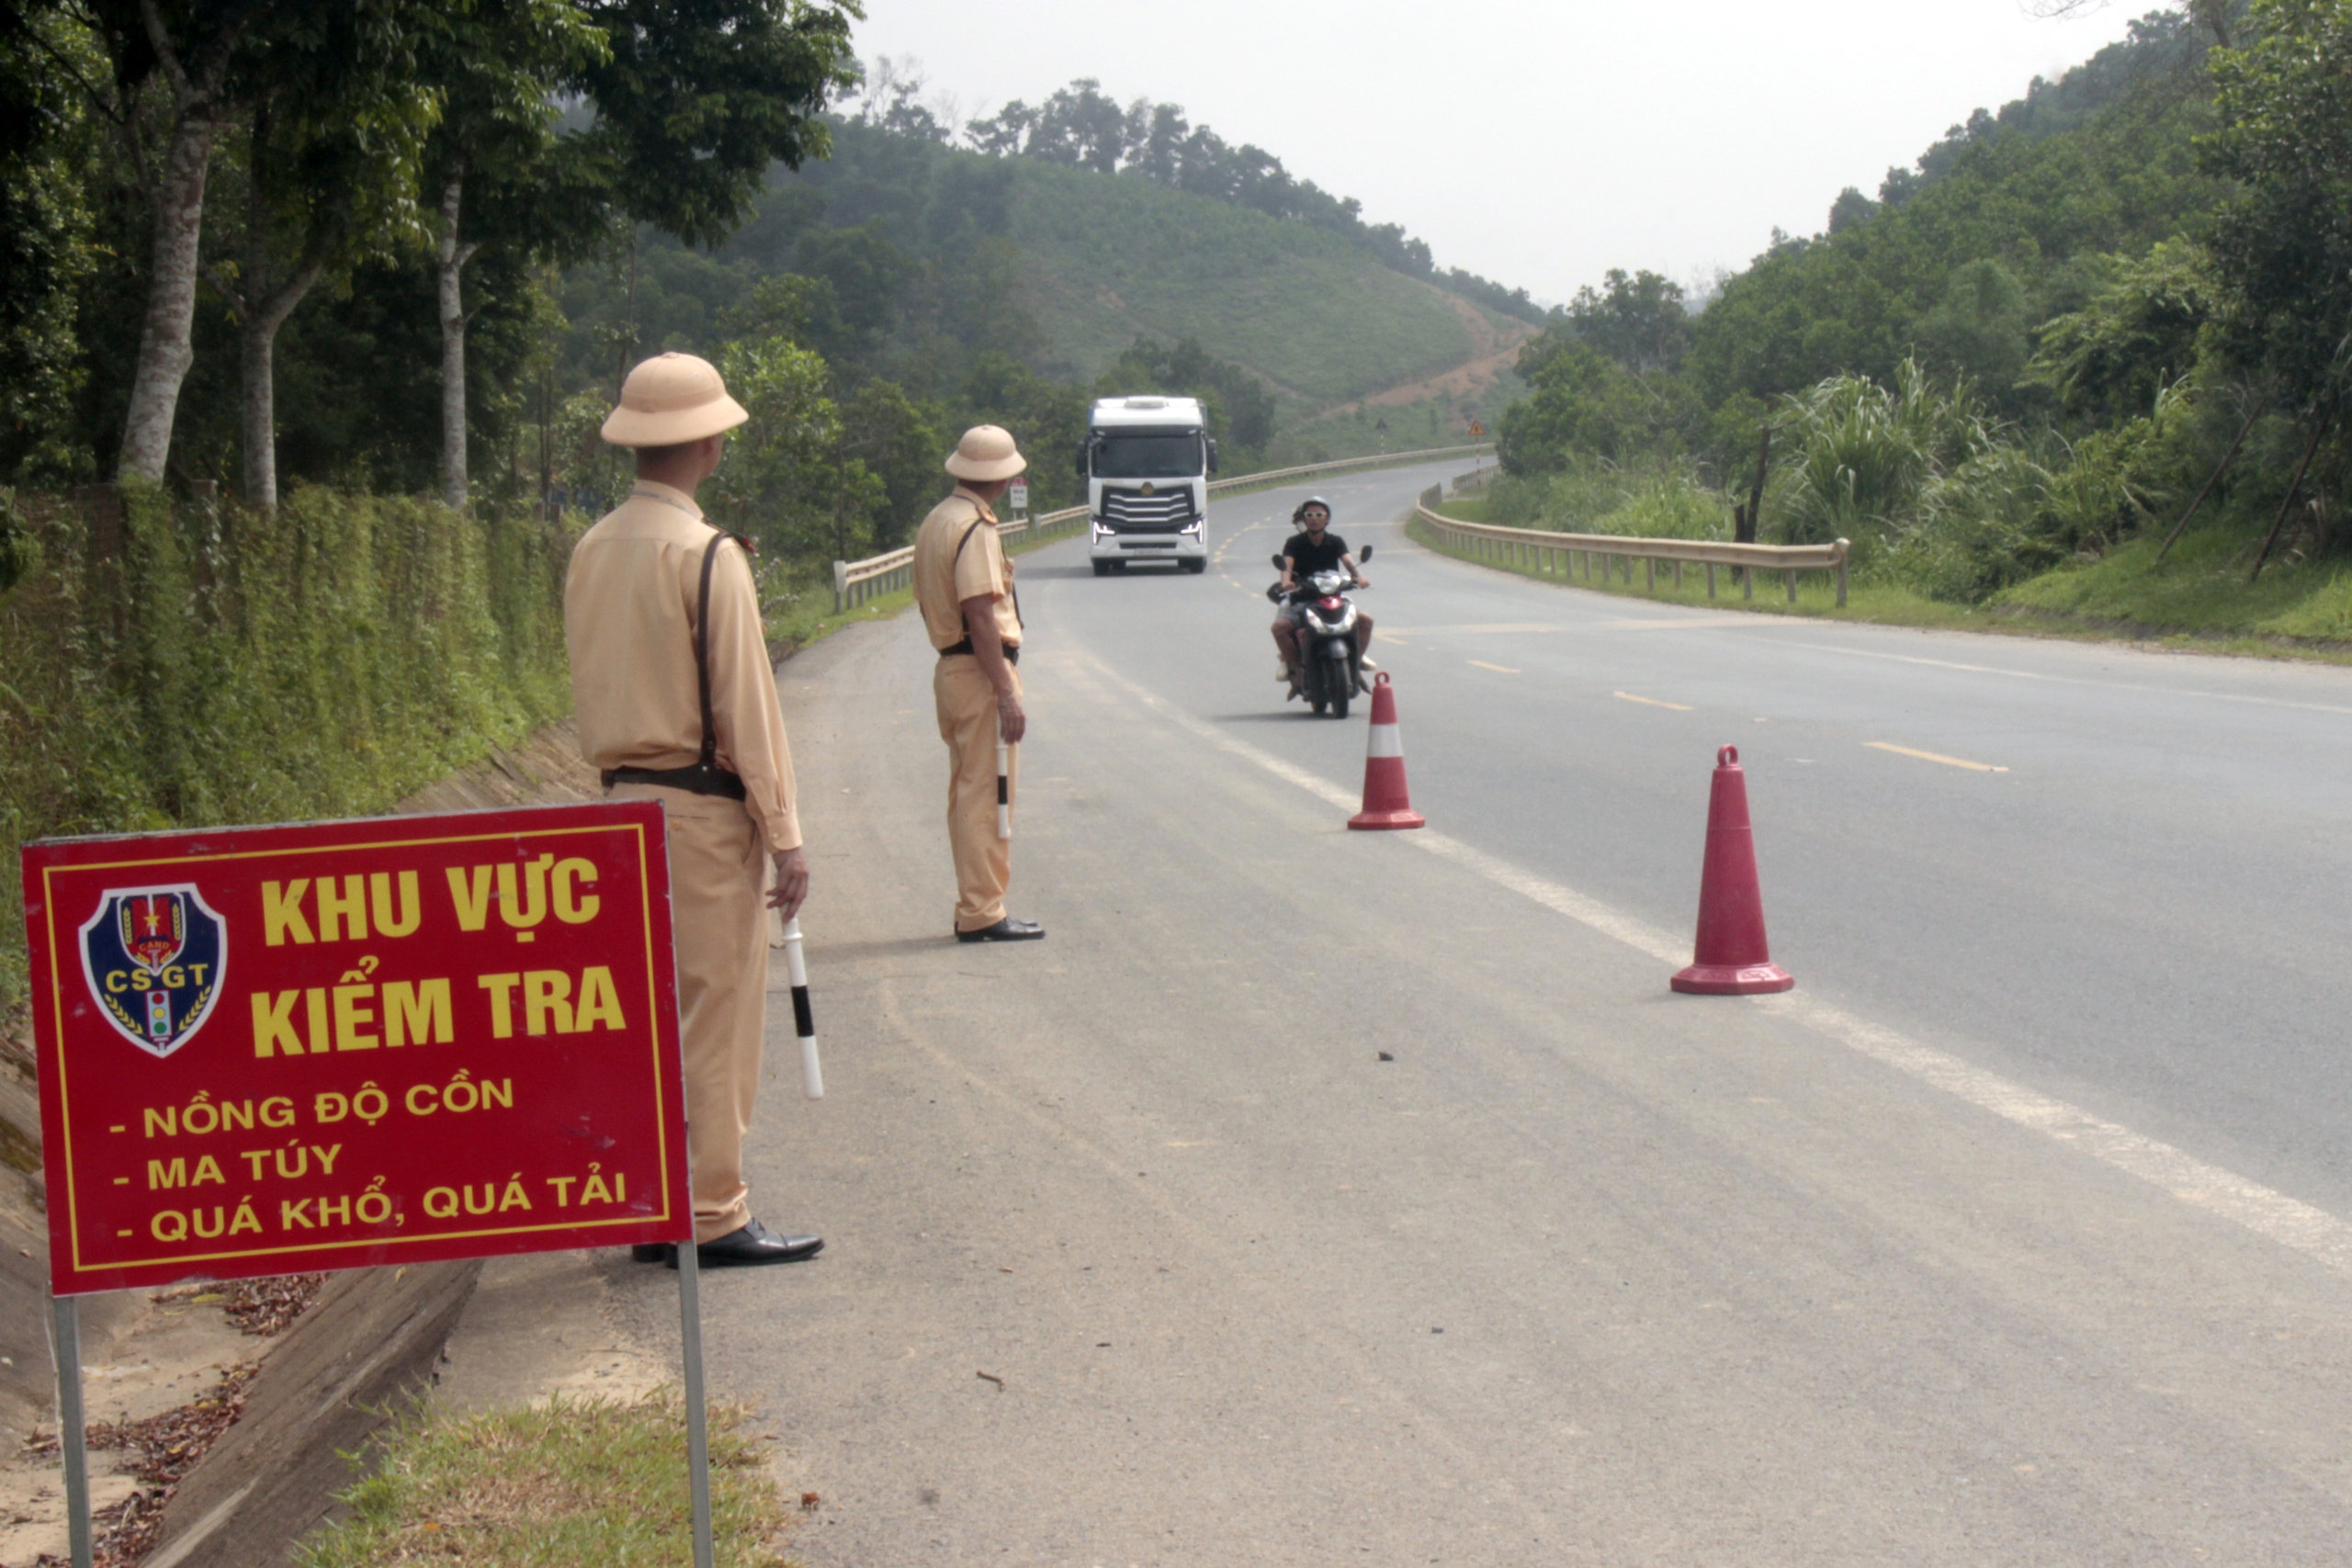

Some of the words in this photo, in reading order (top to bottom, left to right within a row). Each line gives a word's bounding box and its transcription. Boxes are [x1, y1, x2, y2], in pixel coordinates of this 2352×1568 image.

[262, 870, 421, 946] KHU
[446, 853, 600, 943] VỰC
[139, 941, 170, 952] CAND
[251, 955, 454, 1058] KIỂM
[478, 966, 626, 1039] TRA
[144, 1090, 295, 1138] NỒNG
[314, 1081, 389, 1126] ĐỘ
[406, 1069, 514, 1115] CỒN
[148, 1156, 225, 1190] MA
[241, 1139, 342, 1181] TÚY
[151, 1196, 262, 1243] QUÁ
[282, 1175, 404, 1230] KHỔ,
[424, 1172, 532, 1219] QUÁ
[547, 1162, 627, 1208] TẢI
